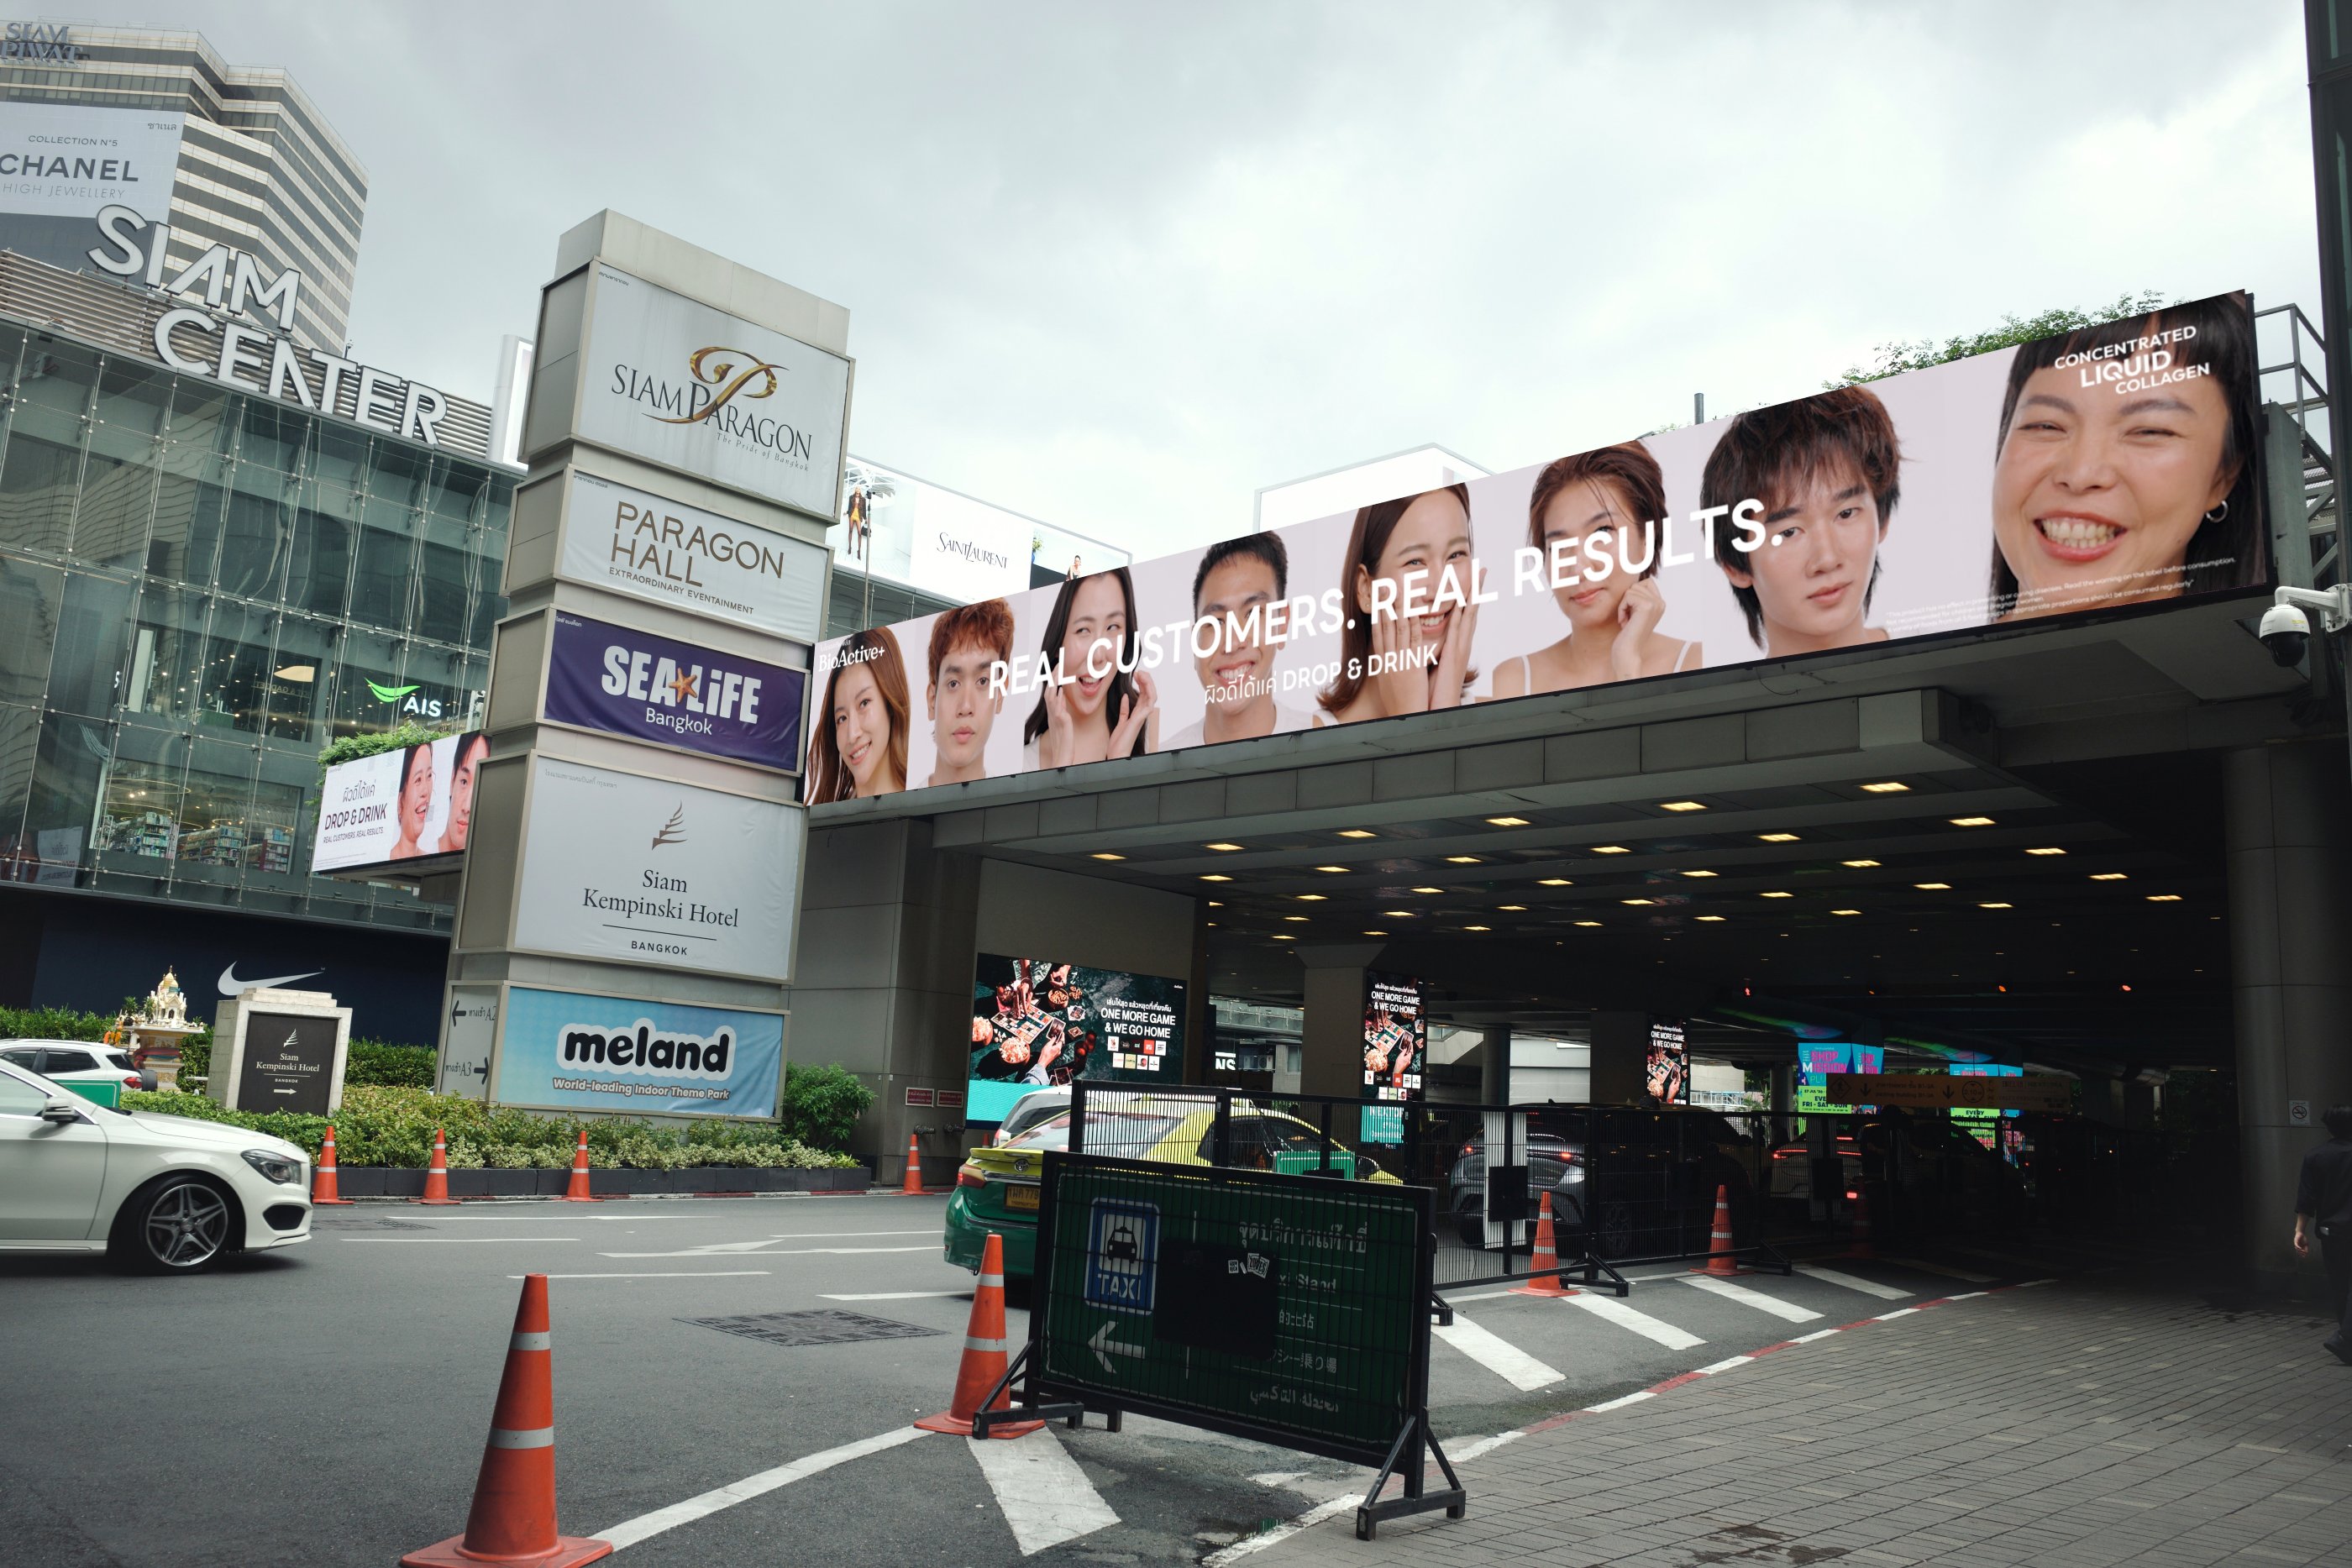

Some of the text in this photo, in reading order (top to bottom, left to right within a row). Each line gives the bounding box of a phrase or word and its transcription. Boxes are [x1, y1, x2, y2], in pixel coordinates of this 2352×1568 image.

[6, 22, 70, 44] SIAM
[1, 41, 83, 64] PIWAT
[29, 135, 97, 145] COLLECTION
[0, 154, 139, 181] CHANEL
[3, 183, 126, 199] HIGH JEWELLERY
[85, 204, 302, 333] SIAM
[2055, 325, 2197, 370] CONCENTRATED
[153, 307, 449, 445] CENTER
[2079, 349, 2172, 388] LIQUID
[2115, 362, 2210, 395] COLLAGEN
[612, 364, 681, 417] SIAM
[717, 432, 810, 473] The Pride of Bangkok
[615, 501, 785, 579] PARAGON
[937, 532, 1007, 569] SAINT LAURENT
[611, 532, 703, 588] HALL
[2064, 581, 2082, 590] Read
[2163, 564, 2186, 574] before
[2187, 557, 2236, 571] consumption.
[609, 566, 754, 615] EXTRAORDINARY EVENTAINMENT
[988, 498, 1783, 700] REAL CUSTOMERS. REAL RESULTS.
[2090, 592, 2112, 600] should
[2123, 585, 2159, 595] consumed
[819, 645, 885, 672] BioActive+
[1283, 660, 1342, 693] DROP
[1347, 657, 1362, 679] &
[1368, 643, 1439, 677] DRINK
[601, 645, 677, 709] SEA
[403, 695, 442, 717] AIS
[645, 707, 712, 737] Bangkok
[325, 802, 388, 831] DROP & DRINK
[323, 836, 333, 844] REAL
[356, 829, 366, 838] REAL
[642, 869, 688, 893] Siam
[582, 889, 739, 928] Kempinski Hotel
[631, 941, 688, 956] BANGKOK
[1371, 991, 1420, 1005] ONE MORE GAME
[1373, 1002, 1417, 1015] & WE GO HOME
[1100, 1008, 1176, 1025] ONE MORE GAME
[1105, 1022, 1171, 1038] & WE GO HOME
[1651, 1030, 1685, 1042] ONE MORE GAME
[280, 1052, 299, 1062] Siam
[564, 1026, 730, 1073] meland
[1810, 1051, 1839, 1062] SHOP
[256, 1061, 320, 1072] Kempinski Hotel
[459, 1061, 472, 1077] A3
[1802, 1062, 1847, 1073] MISSION
[553, 1078, 731, 1100] World-leading Indoor Theme Park
[1097, 1273, 1141, 1301] TAXI
[1296, 1273, 1336, 1293] Stand
[1278, 1308, 1315, 1330] 的士站
